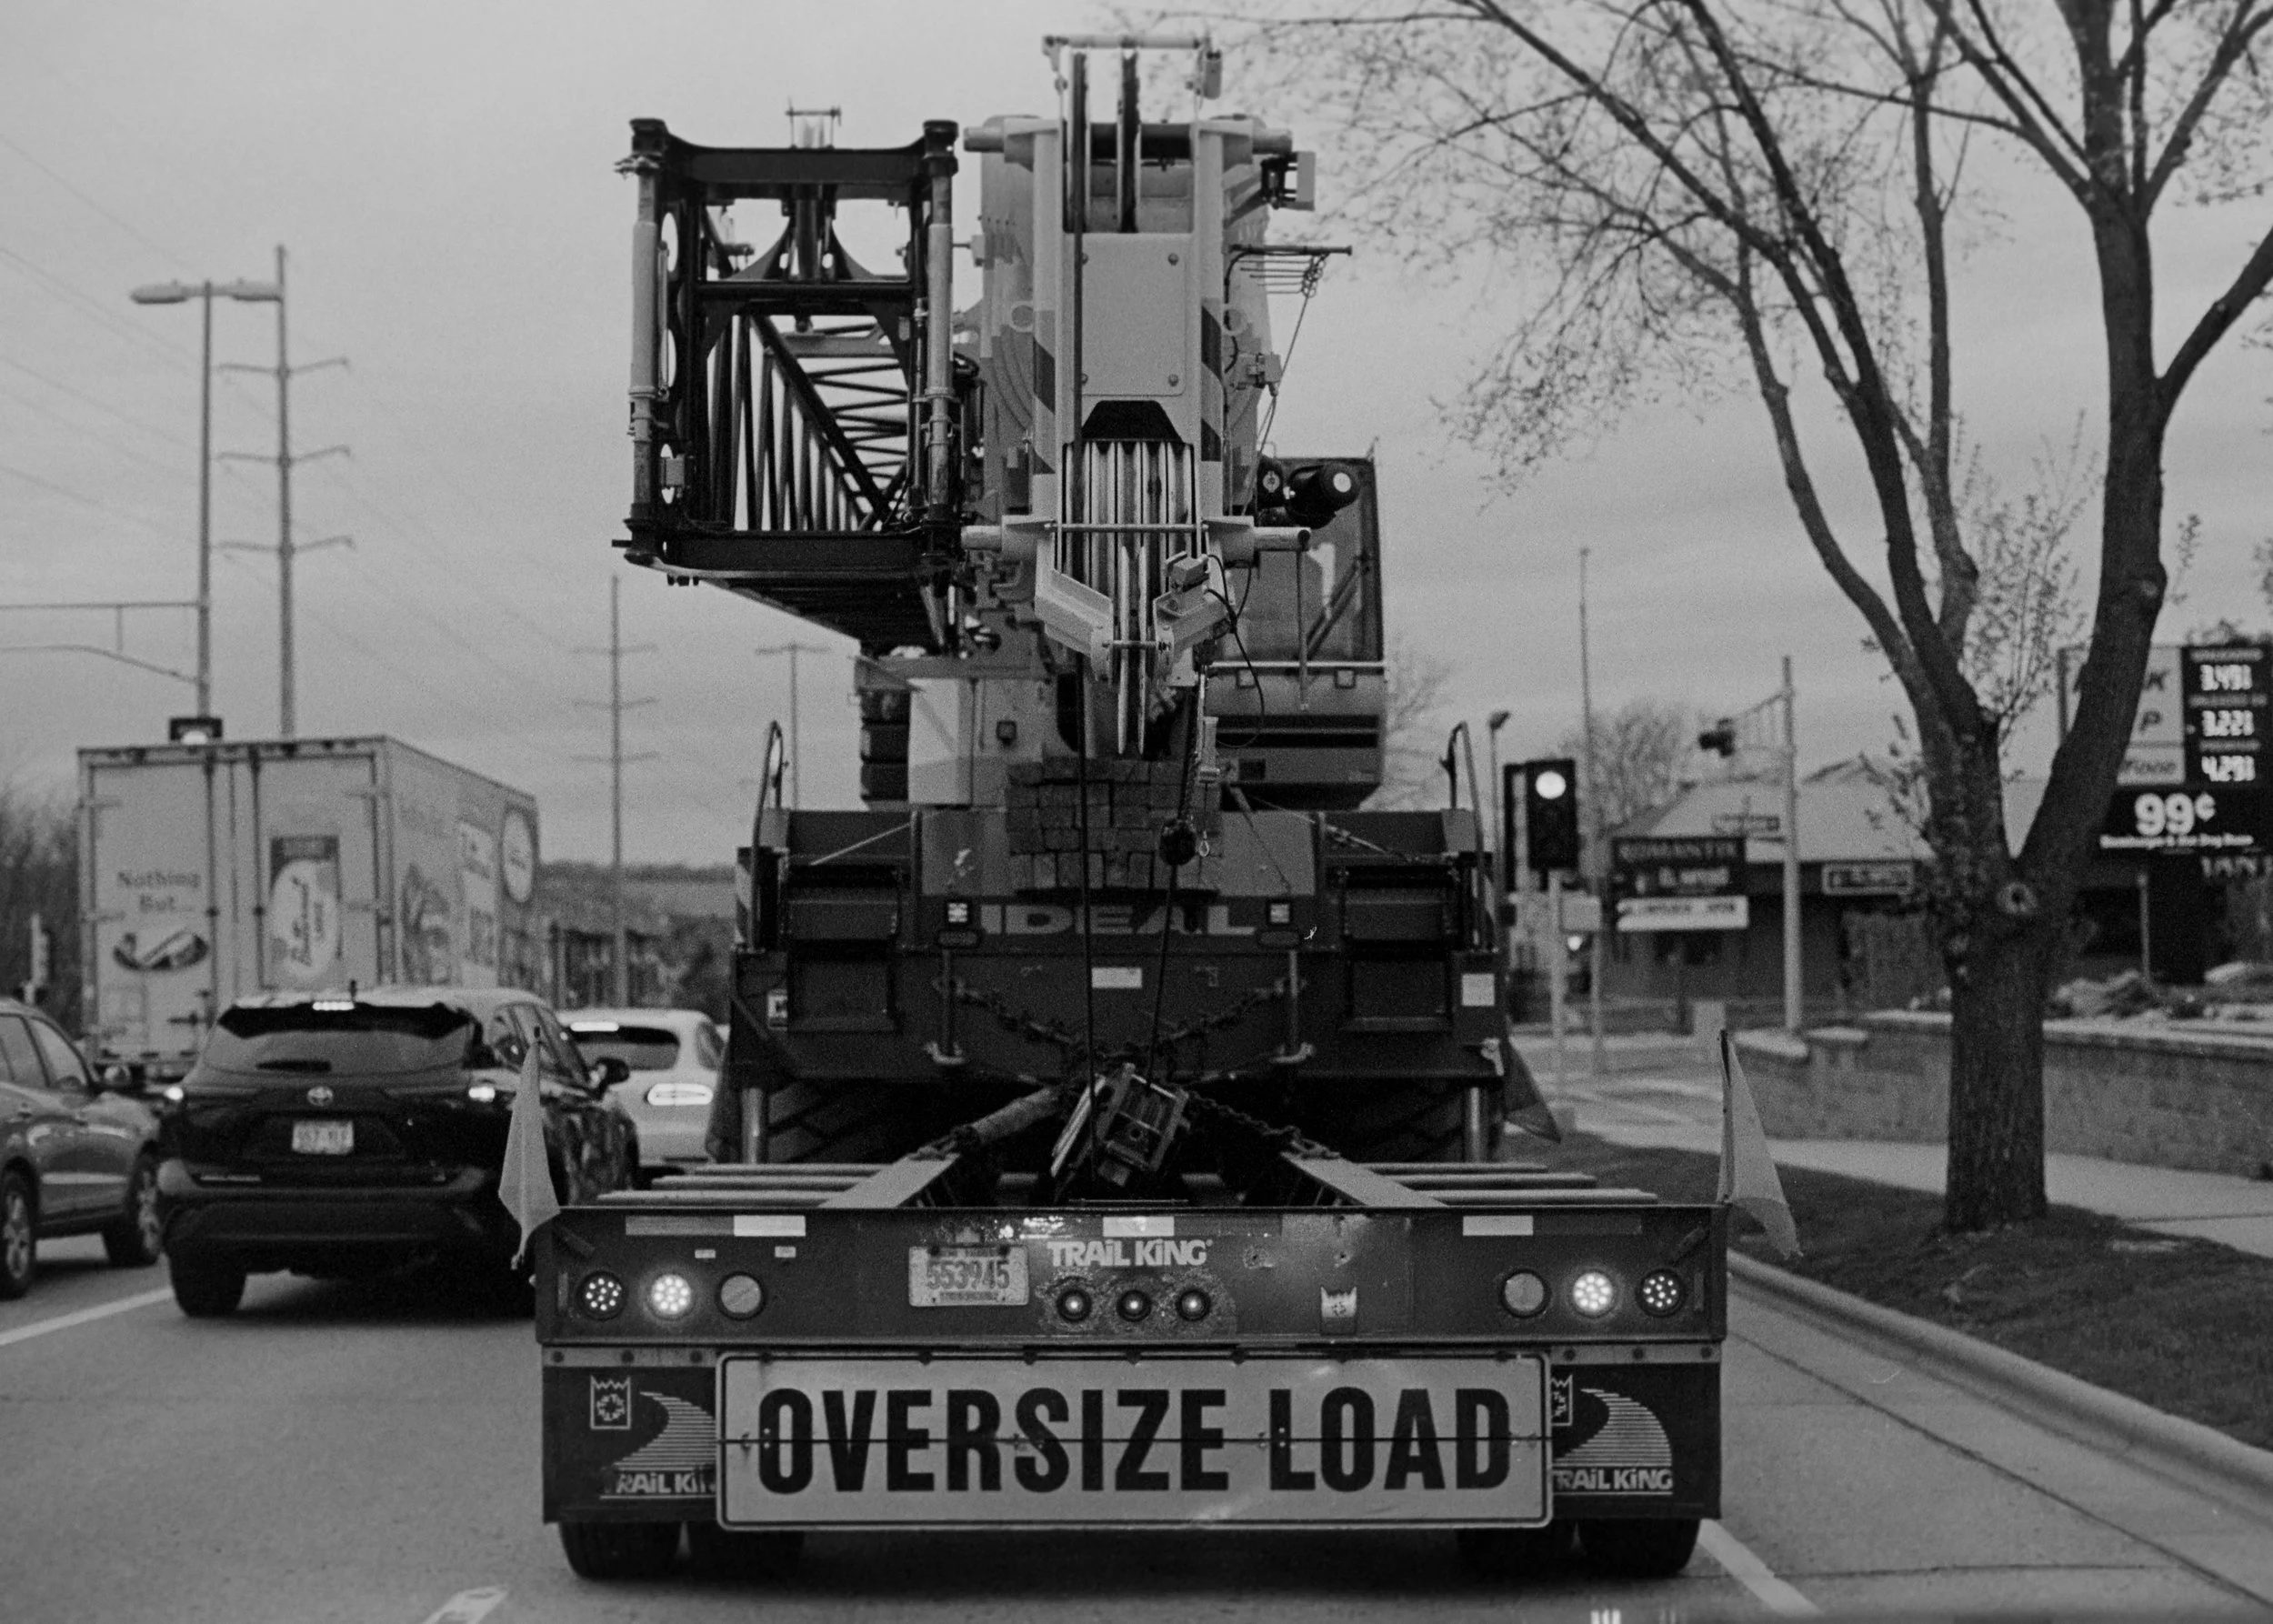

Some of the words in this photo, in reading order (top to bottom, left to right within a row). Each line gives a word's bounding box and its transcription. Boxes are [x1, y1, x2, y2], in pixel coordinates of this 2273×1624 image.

[2134, 791, 2216, 837] 99¢
[980, 905, 1255, 935] IDEAL
[758, 1387, 1229, 1494] OVERSIZE
[1268, 1387, 1510, 1492] LOAD
